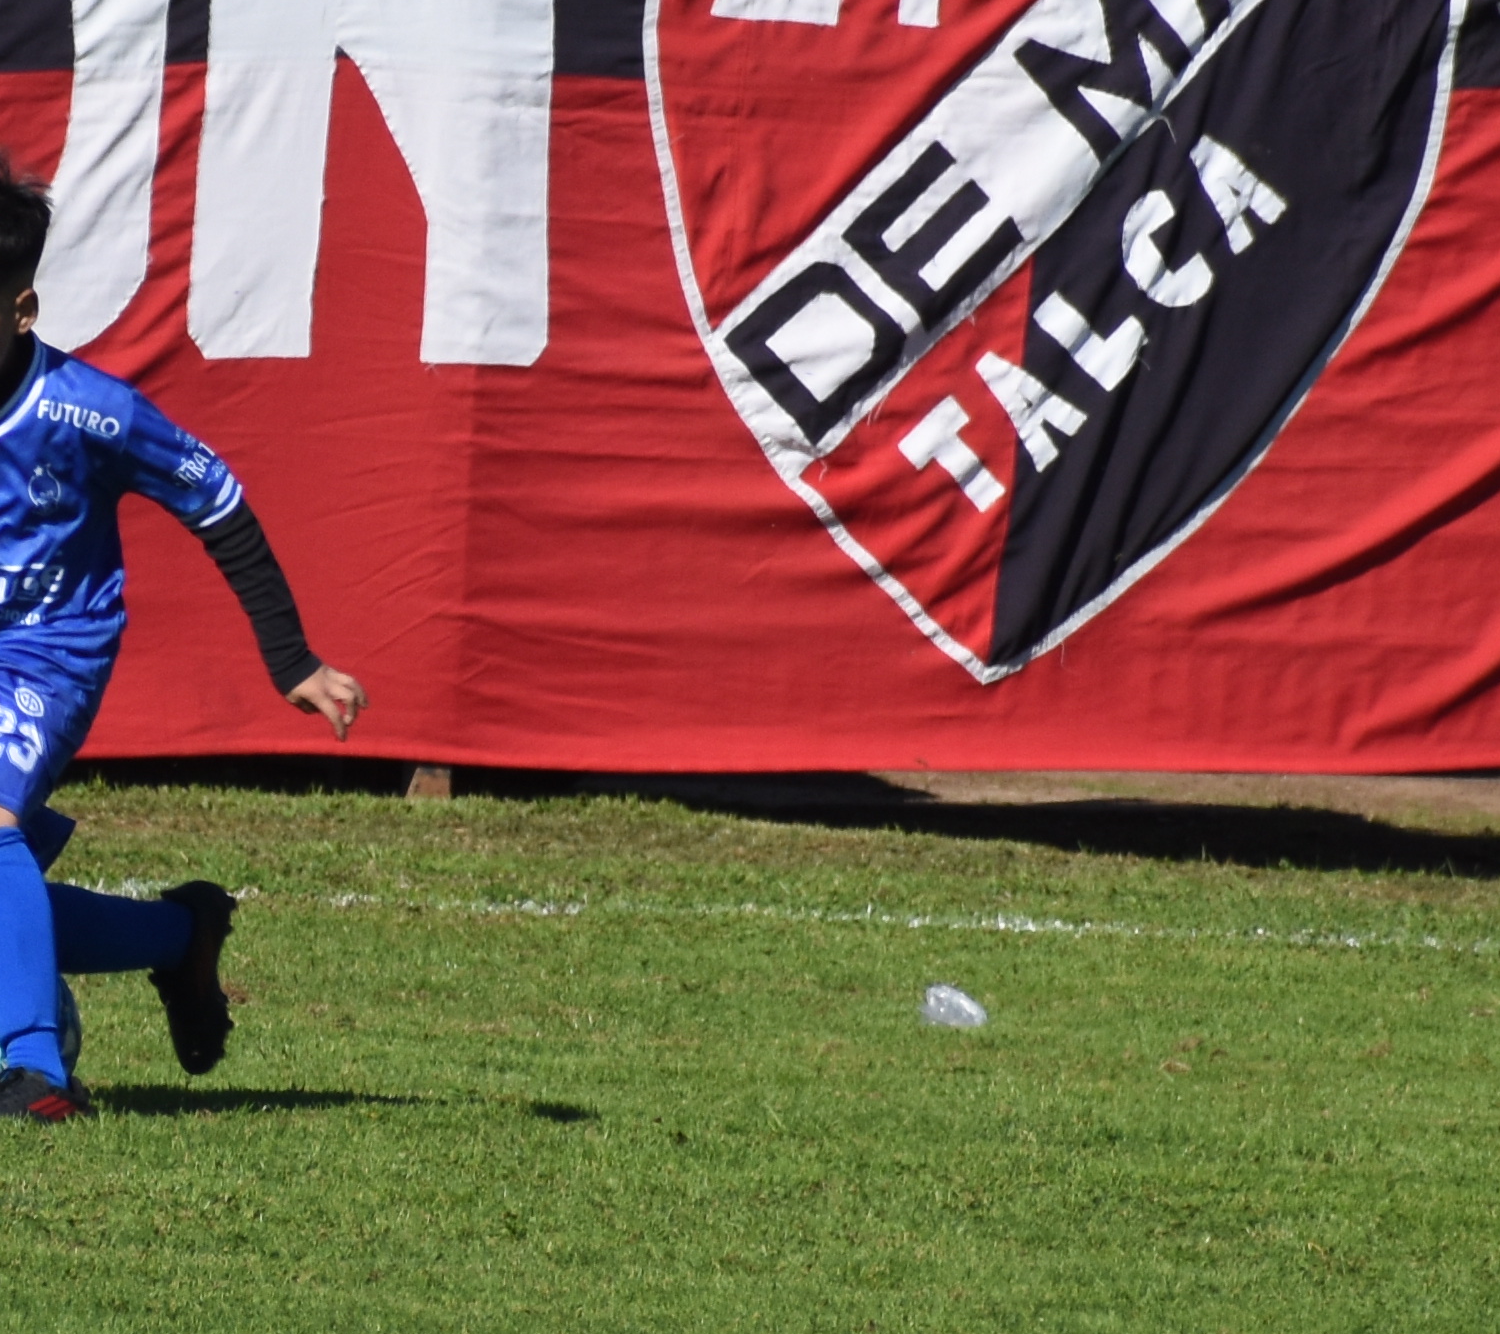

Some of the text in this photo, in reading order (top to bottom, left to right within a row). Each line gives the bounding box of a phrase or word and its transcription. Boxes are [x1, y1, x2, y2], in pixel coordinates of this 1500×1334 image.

[36, 399, 121, 437] FUTURO
[724, 141, 1026, 447] DE
[897, 134, 1288, 513] TALCA
